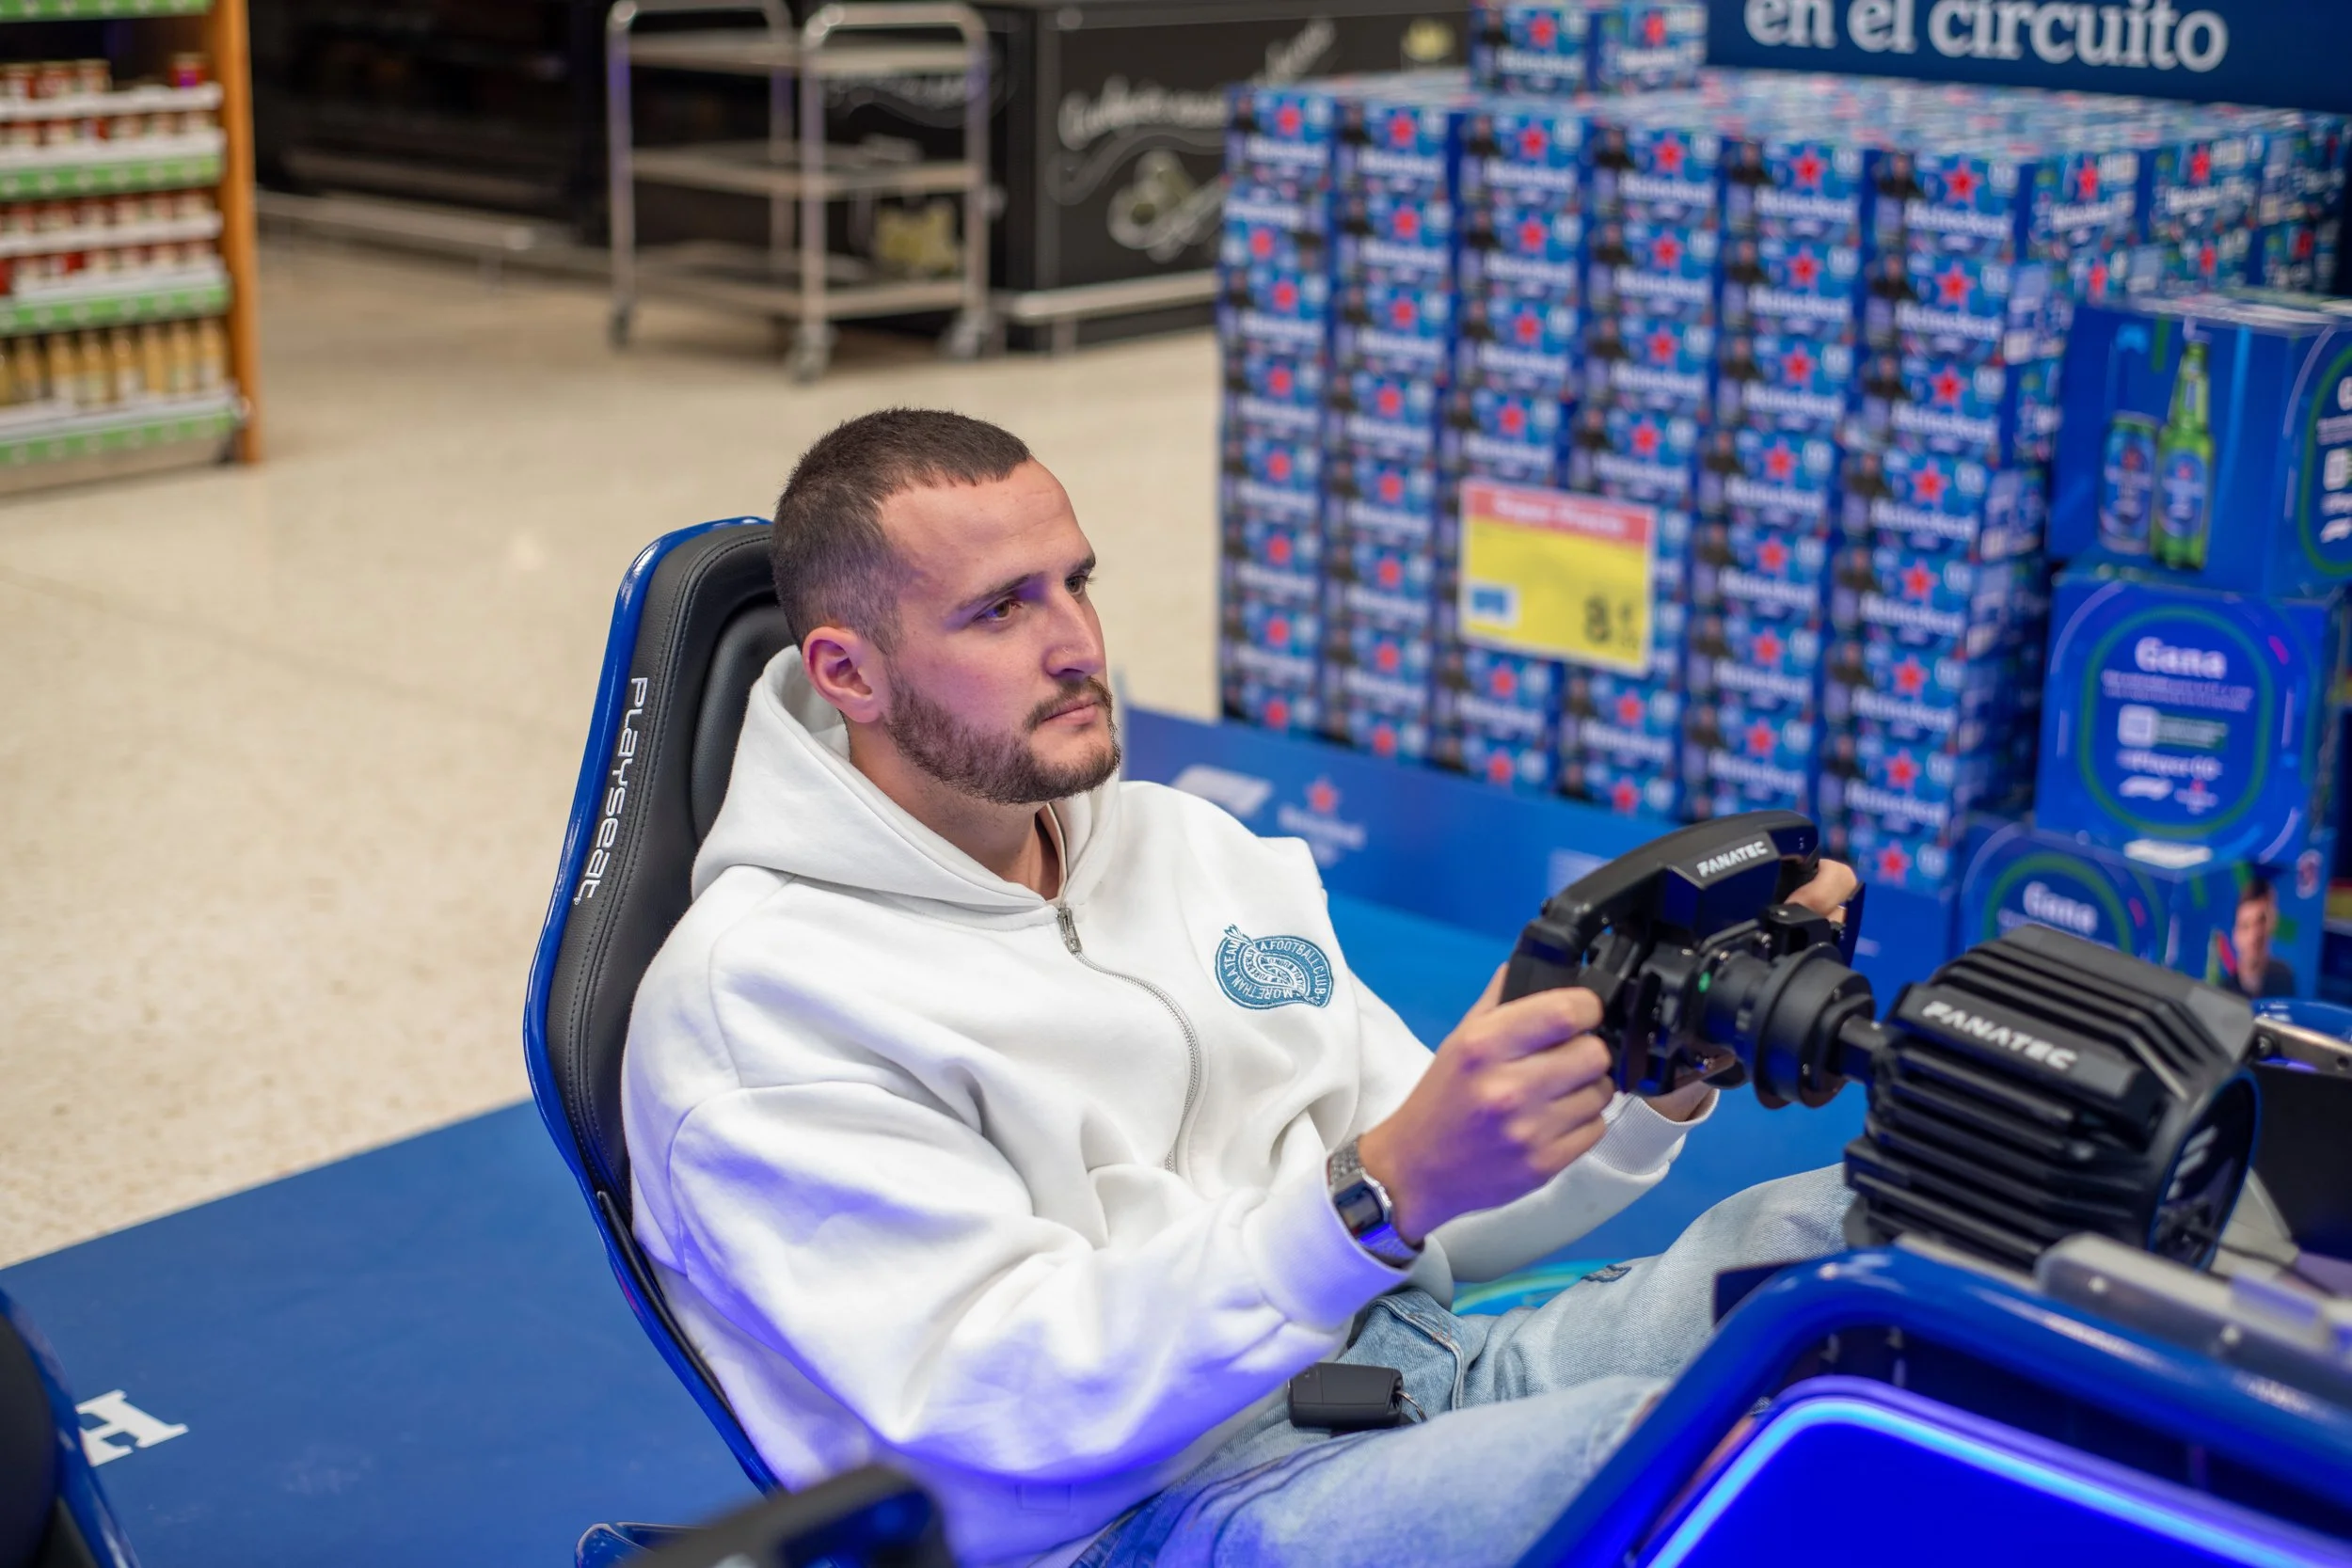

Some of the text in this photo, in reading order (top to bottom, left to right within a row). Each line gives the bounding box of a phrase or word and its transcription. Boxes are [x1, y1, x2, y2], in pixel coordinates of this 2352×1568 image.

[1744, 0, 2229, 72] en el circuito
[2135, 636, 2227, 679] Gana
[1696, 840, 1769, 878] FANATEC
[1224, 940, 1241, 969] TEAM
[1270, 941, 1321, 969] FOOTBALL
[1312, 966, 1327, 994] CLUB
[1232, 977, 1256, 998] THAN
[1257, 988, 1294, 1000] MORE
[1921, 1000, 2078, 1070] FANATEC
